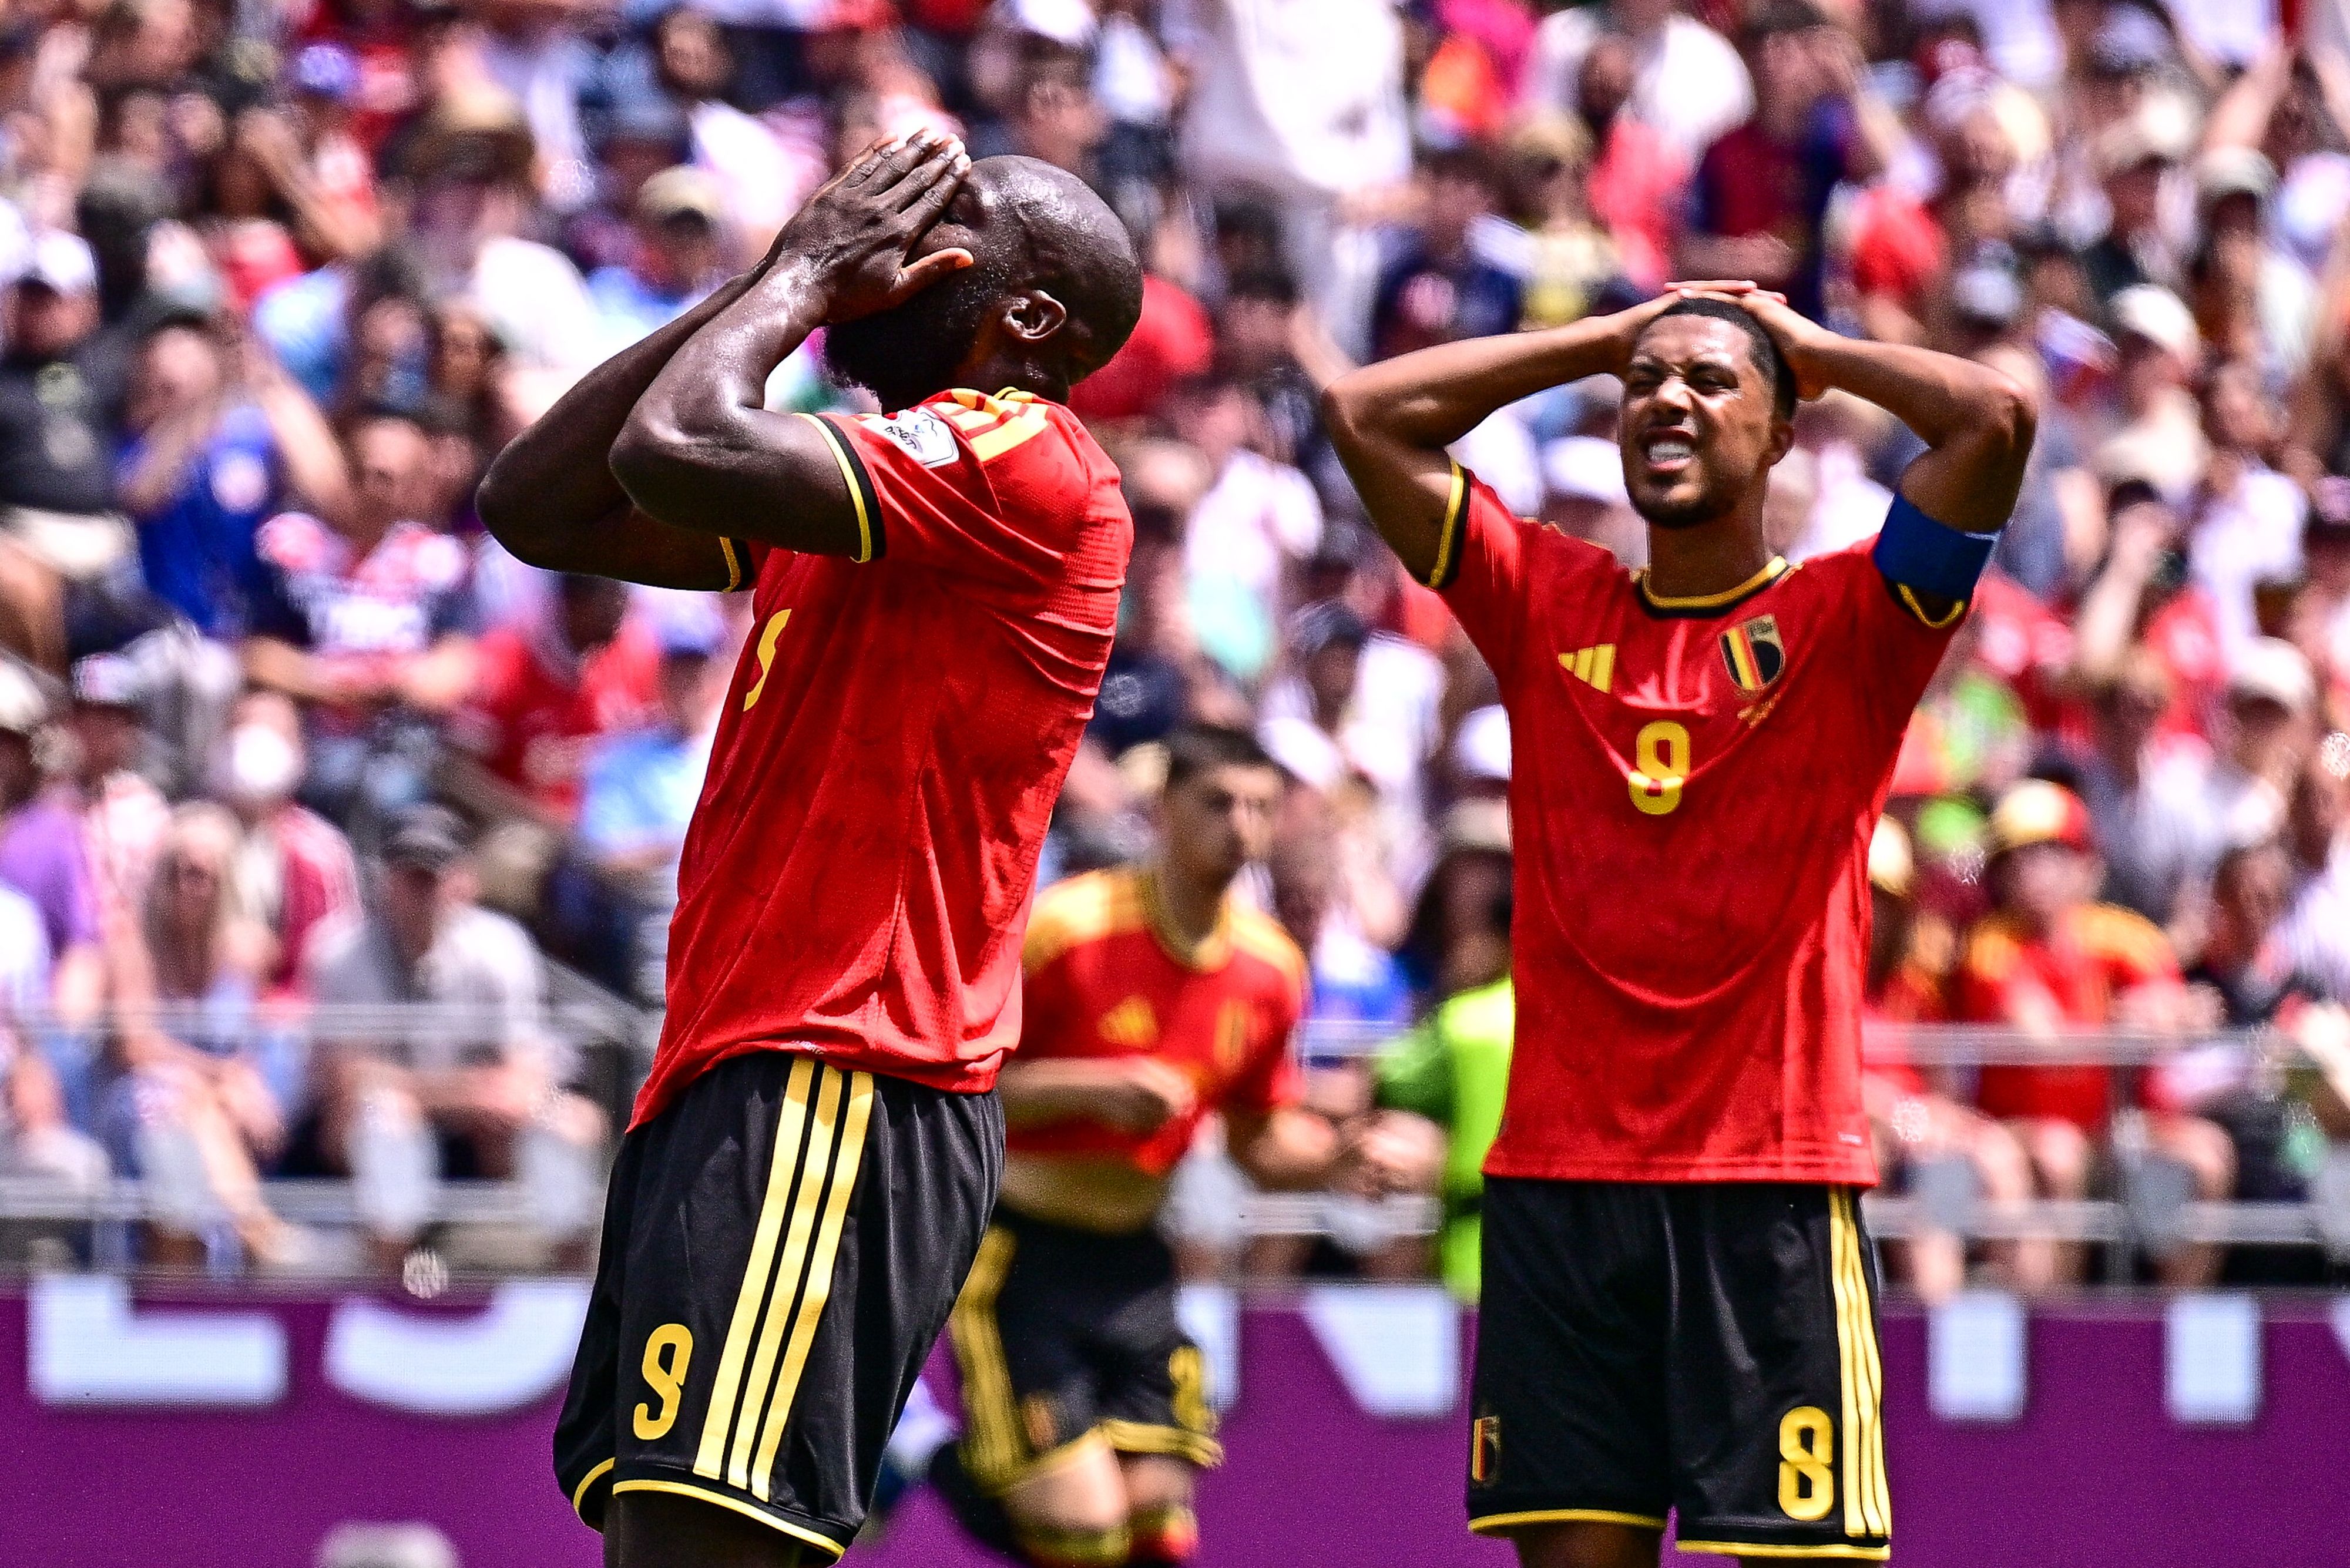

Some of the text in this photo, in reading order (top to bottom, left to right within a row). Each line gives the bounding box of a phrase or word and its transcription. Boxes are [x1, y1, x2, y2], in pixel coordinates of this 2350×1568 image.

[1629, 720, 1690, 815] 8
[633, 1323, 693, 1441] 9
[1778, 1406, 1835, 1520] 8
